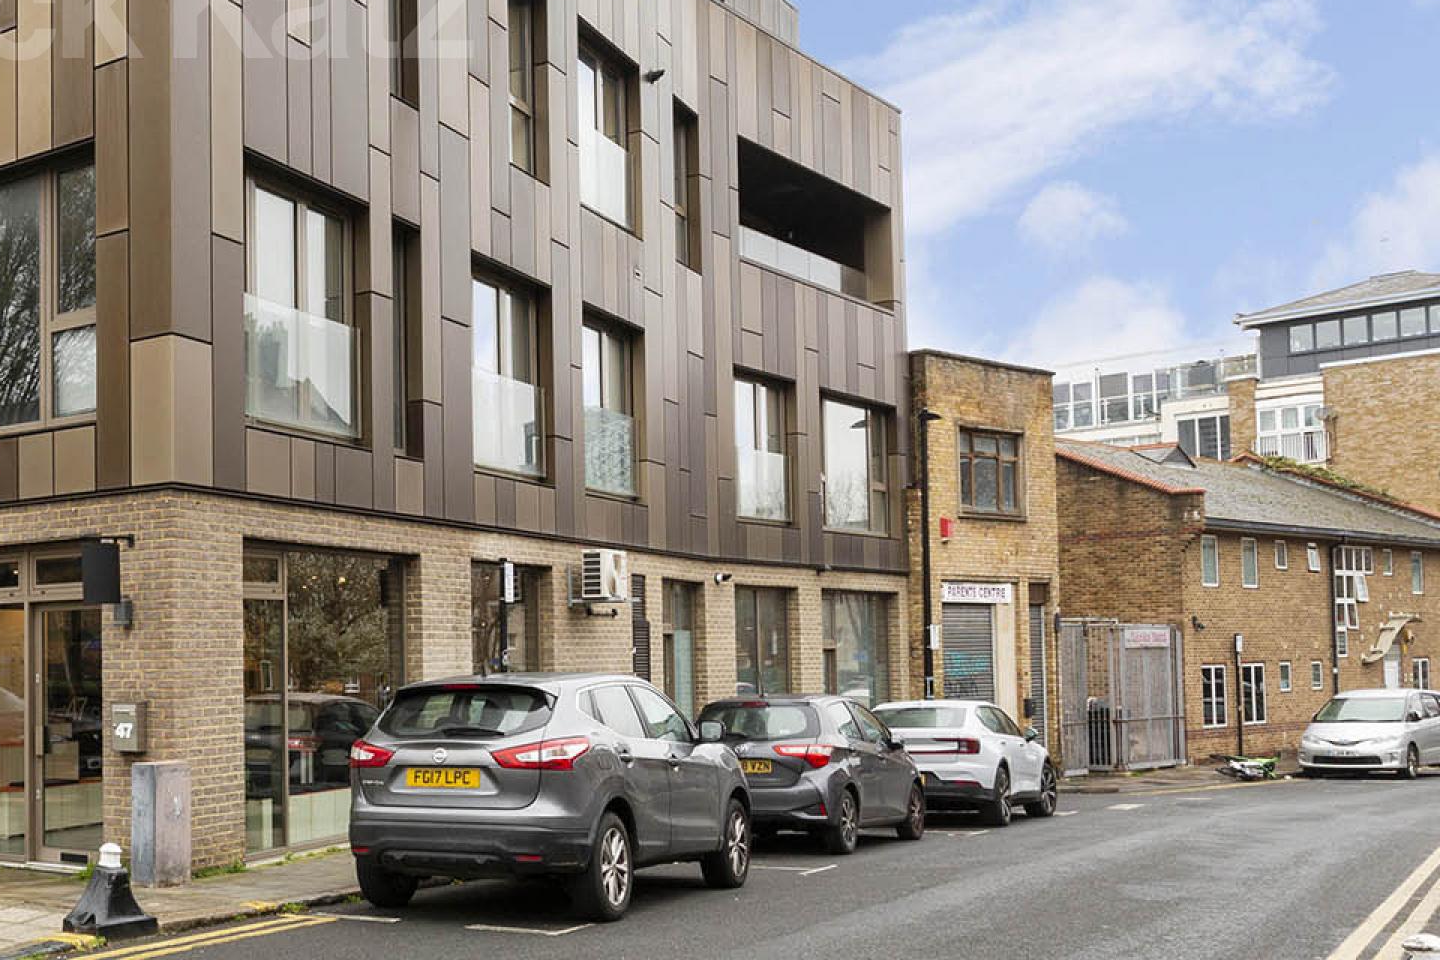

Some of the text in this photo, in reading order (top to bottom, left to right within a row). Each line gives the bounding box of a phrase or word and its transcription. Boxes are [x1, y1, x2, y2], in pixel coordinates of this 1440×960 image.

[114, 722, 133, 739] 47
[413, 769, 471, 784] FG17 LPC
